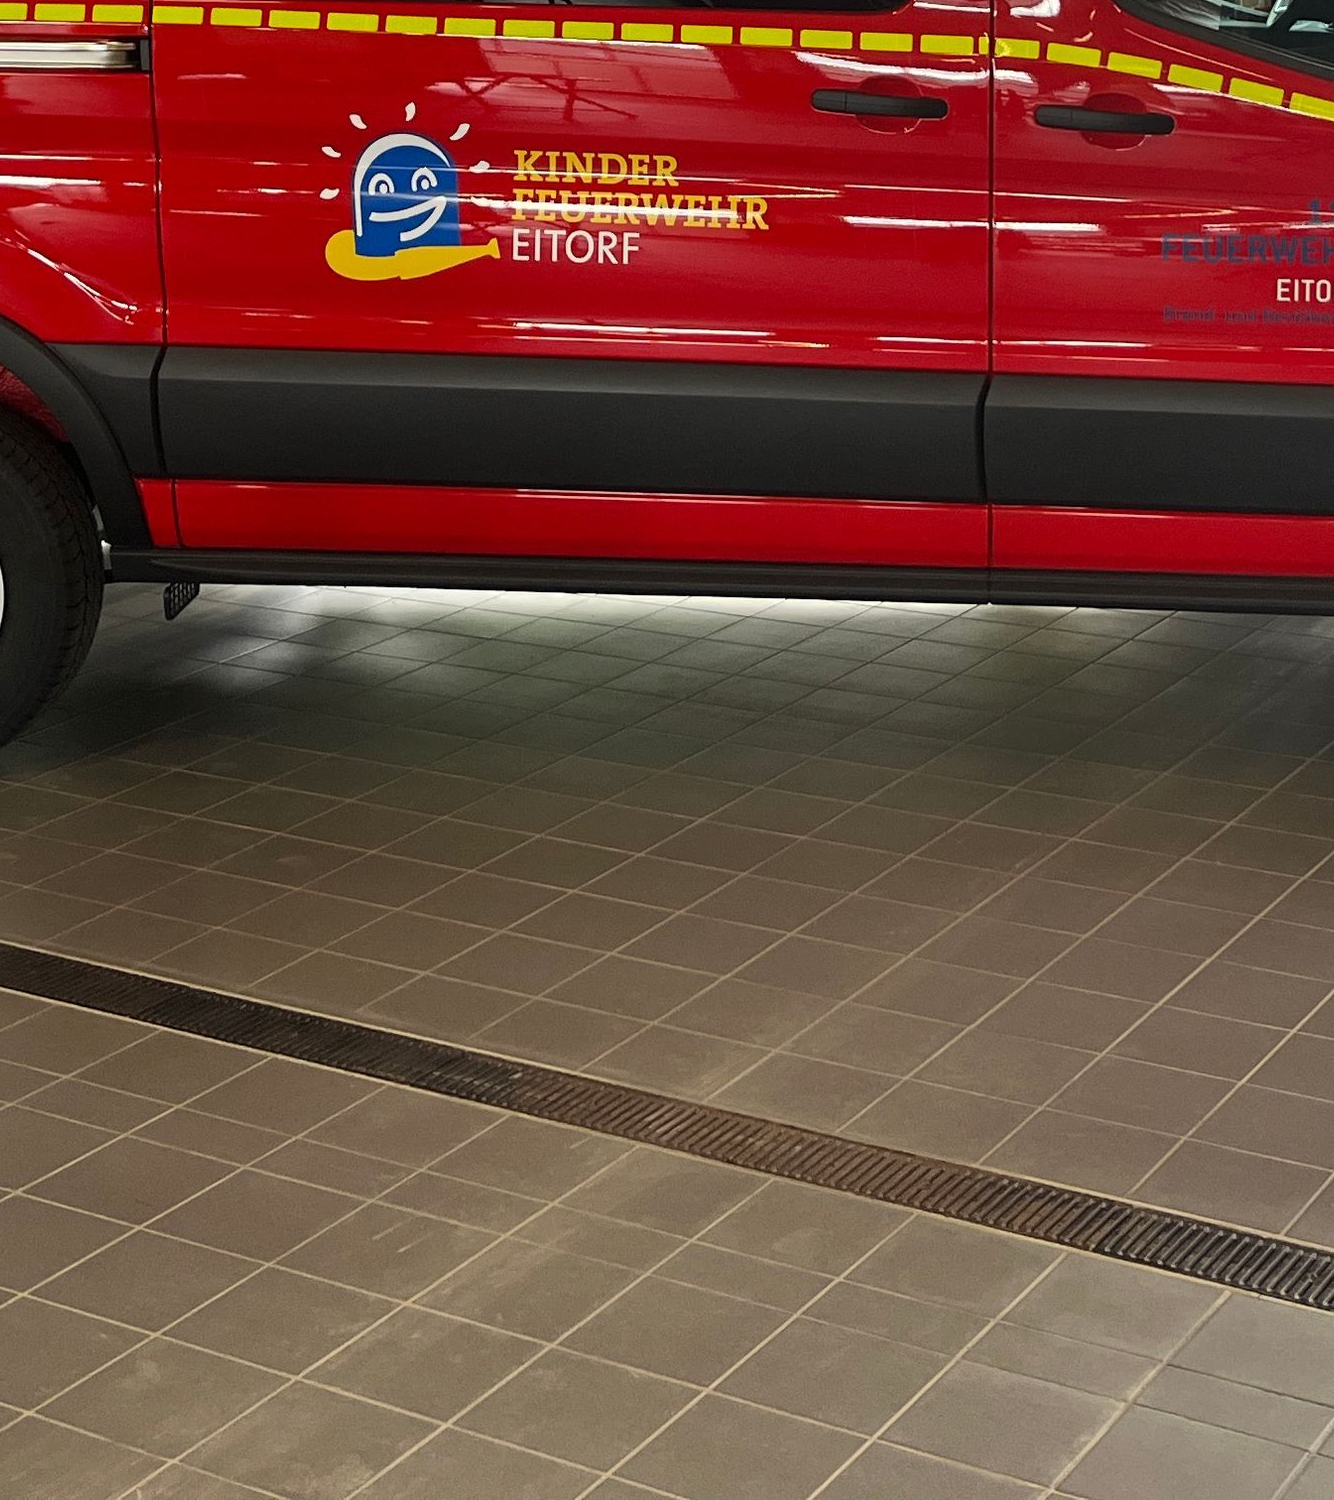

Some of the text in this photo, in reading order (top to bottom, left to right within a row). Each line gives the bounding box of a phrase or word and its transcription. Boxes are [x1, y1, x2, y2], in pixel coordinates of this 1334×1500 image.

[513, 149, 679, 187] KINDER
[511, 188, 770, 231] FEUERWEHR
[512, 228, 641, 265] EITORF
